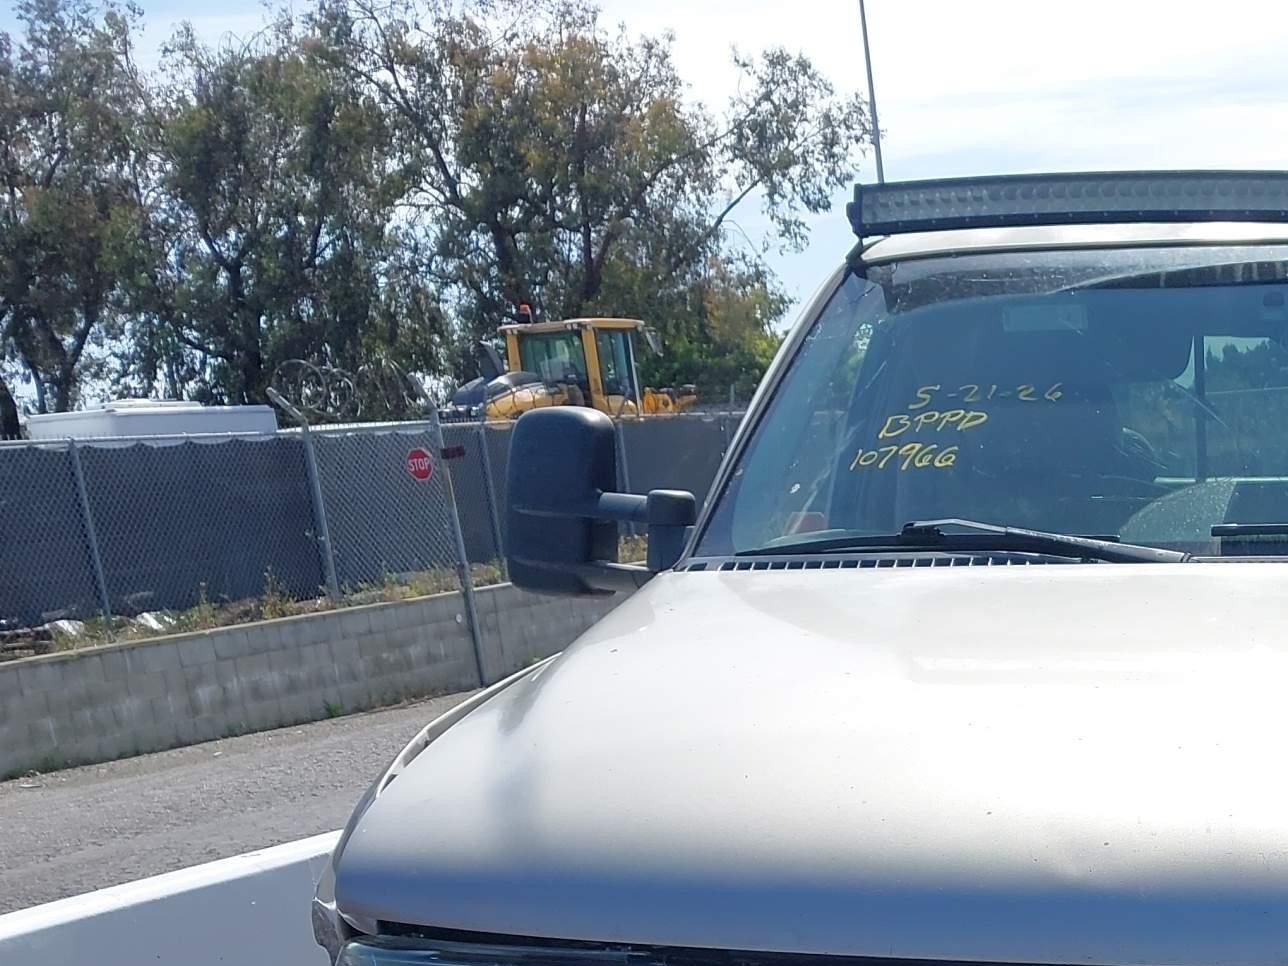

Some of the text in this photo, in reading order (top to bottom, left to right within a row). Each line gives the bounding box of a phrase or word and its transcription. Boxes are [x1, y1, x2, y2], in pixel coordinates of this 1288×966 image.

[878, 409, 989, 439] BPPD
[408, 457, 430, 472] STOP
[849, 443, 960, 470] 107966
